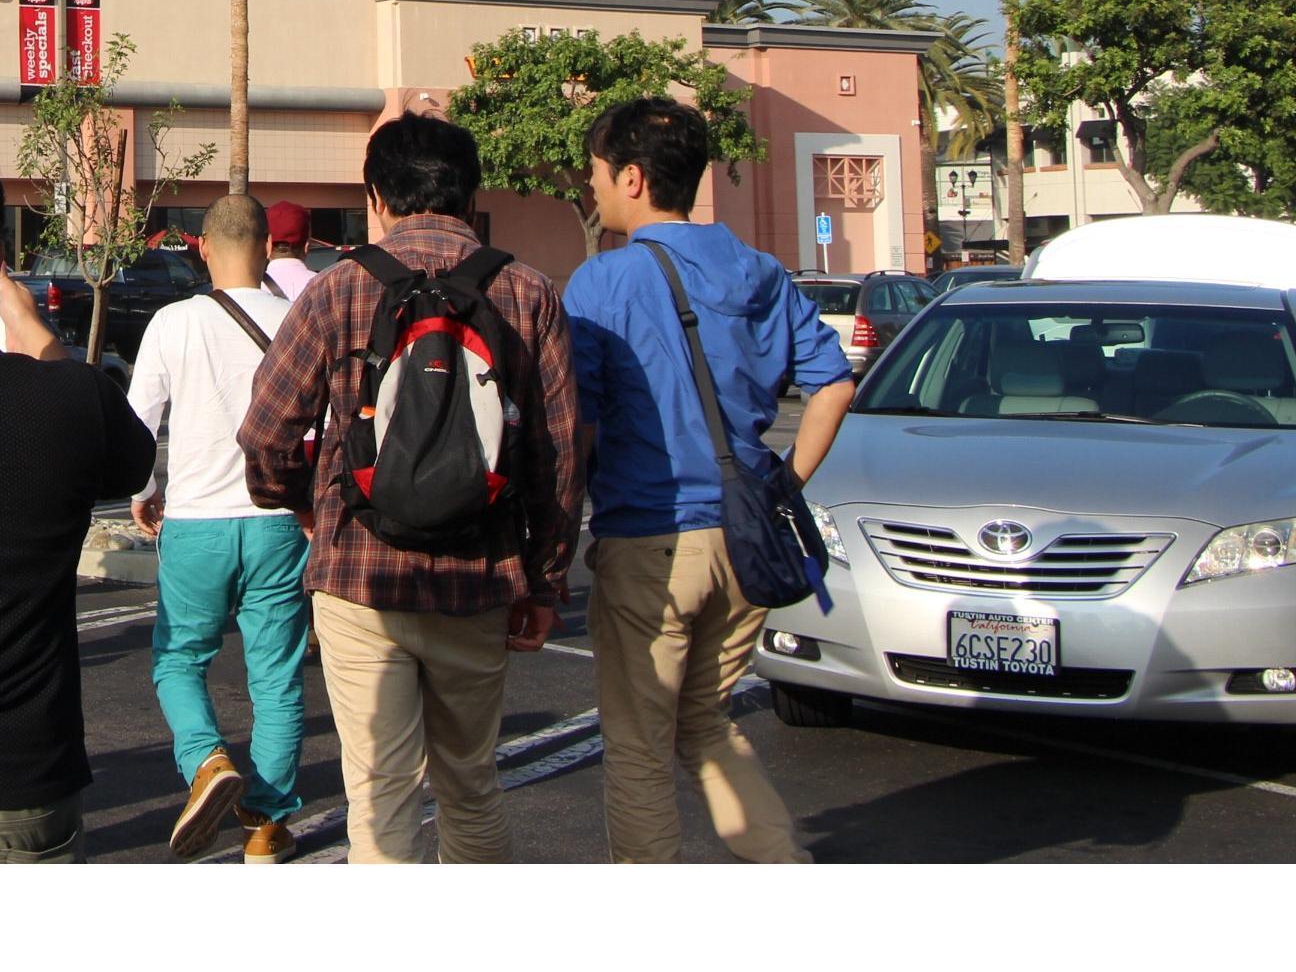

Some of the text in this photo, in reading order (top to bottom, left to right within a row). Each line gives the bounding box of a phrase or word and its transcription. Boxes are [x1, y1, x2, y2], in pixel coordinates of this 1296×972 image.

[24, 28, 38, 81] weekly
[35, 11, 51, 78] specials
[953, 611, 1054, 626] TUSTIN AUTO CENTER
[970, 618, 1035, 634] California
[956, 633, 1051, 664] 6CSE230
[953, 657, 1055, 676] TUSTIN TOYOTA
